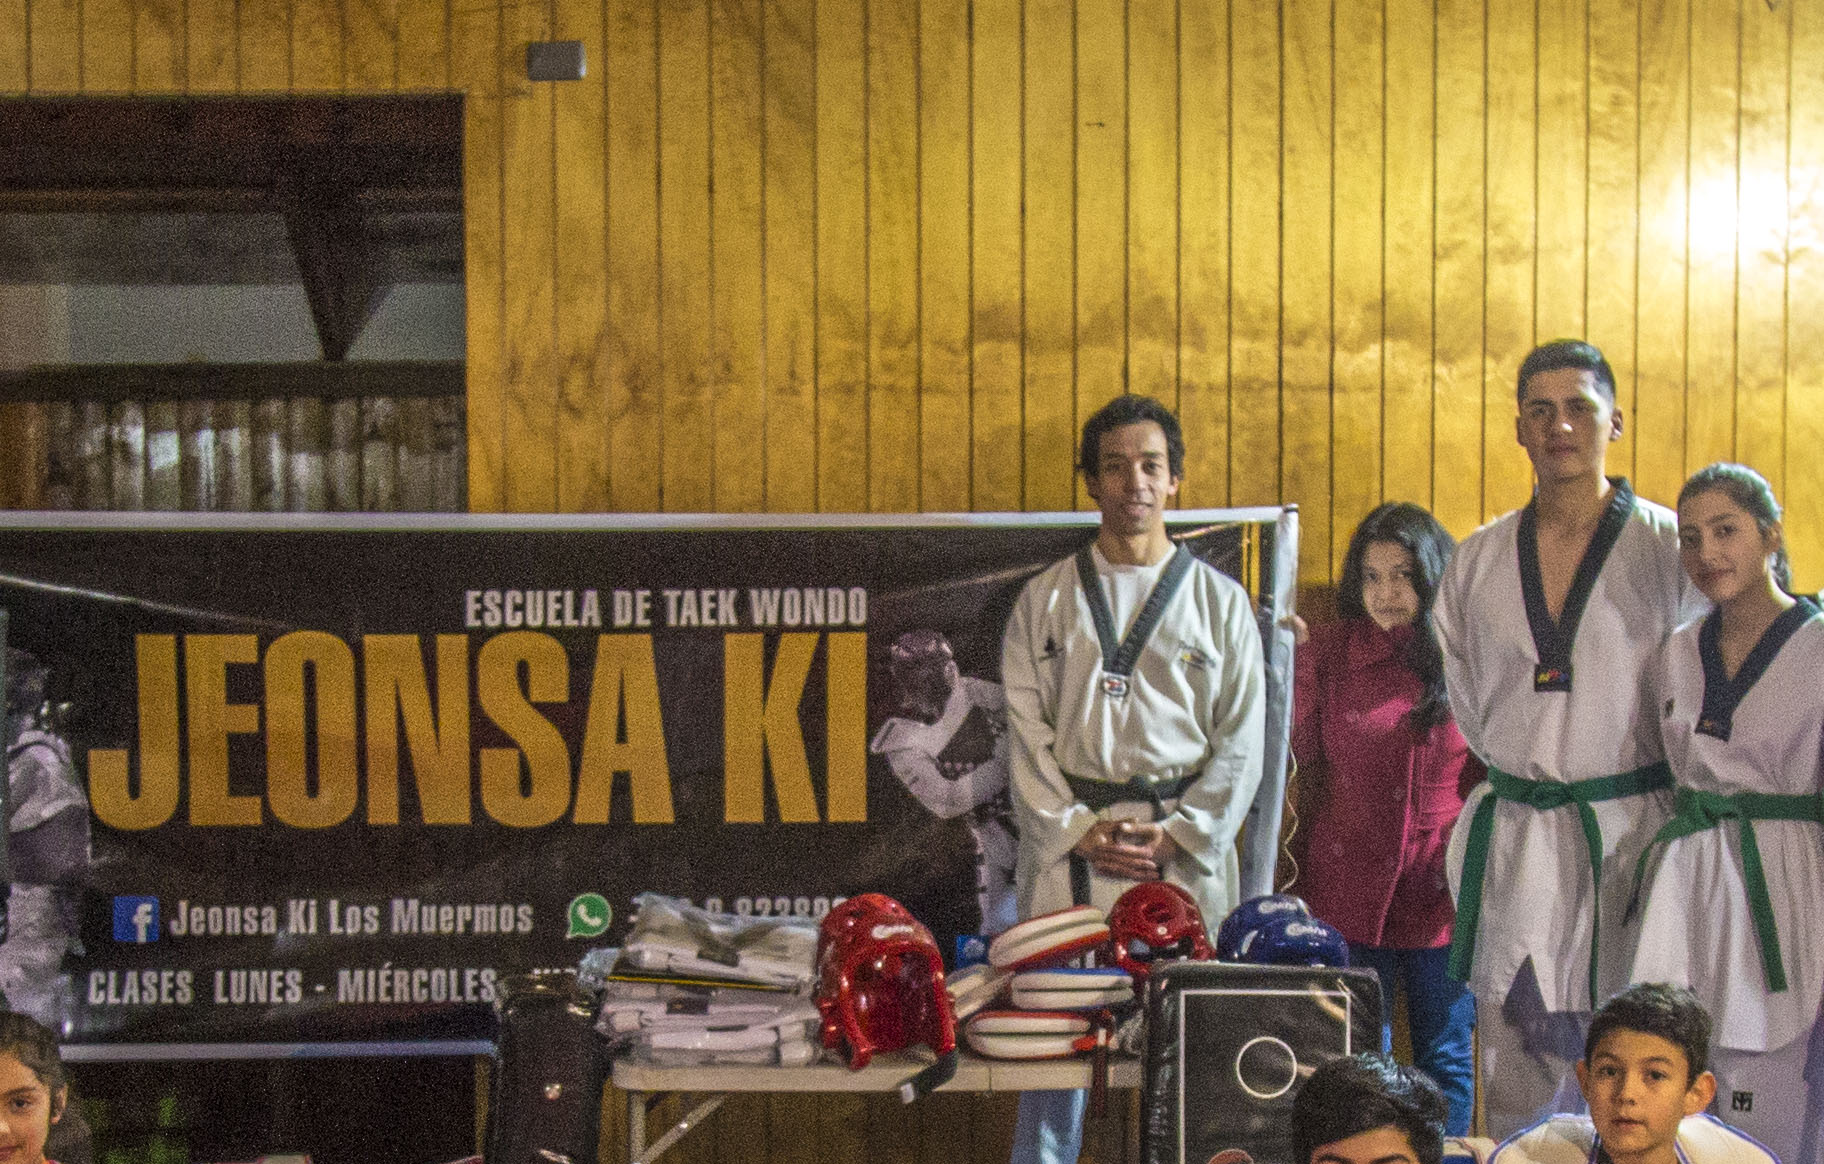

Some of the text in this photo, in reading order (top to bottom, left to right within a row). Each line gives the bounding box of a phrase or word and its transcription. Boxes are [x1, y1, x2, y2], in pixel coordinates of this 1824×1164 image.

[465, 586, 868, 628] ESCUELA DE TAEK WONDO
[87, 629, 868, 830] JEONSA KI
[170, 899, 534, 935] Jeonsa Ki Los Muermos
[87, 970, 194, 1004] CLASES
[214, 970, 303, 1003] LUNES
[336, 961, 497, 1003] MIÉRCOLES
